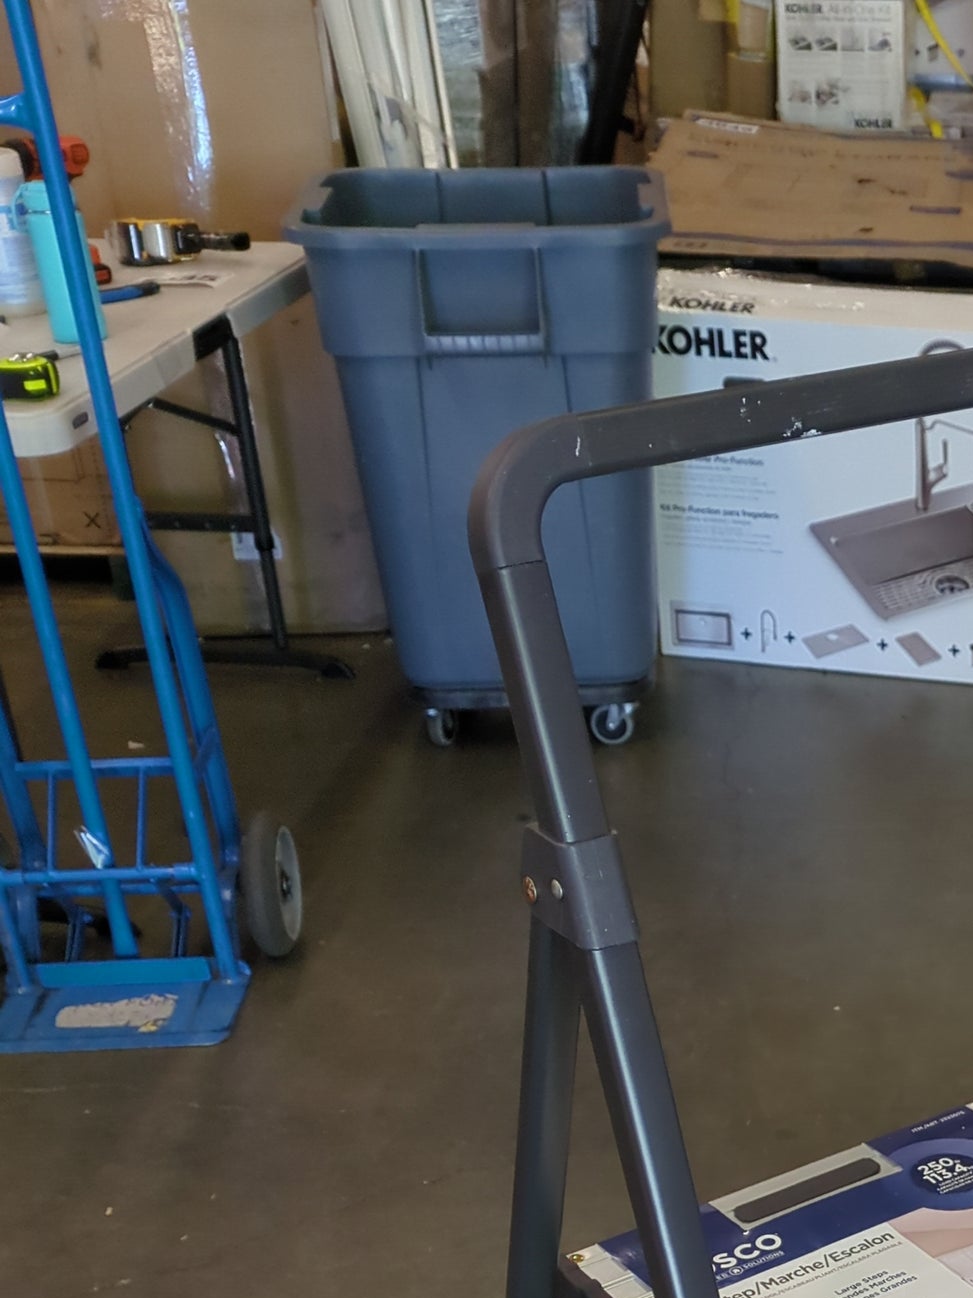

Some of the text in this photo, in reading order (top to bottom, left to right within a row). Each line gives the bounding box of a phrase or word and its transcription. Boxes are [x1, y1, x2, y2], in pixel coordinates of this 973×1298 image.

[785, 4, 823, 13] KOHLER
[854, 118, 893, 129] KOHLER
[669, 297, 756, 314] KOHLER
[652, 325, 770, 362] KOHLER
[917, 1157, 954, 1175] 250
[923, 1164, 968, 1184] 113.4
[712, 1234, 782, 1273] SCO
[743, 1250, 785, 1270] SOLUTIONS
[834, 1269, 889, 1296] Large Steps
[869, 1271, 908, 1290] Marches
[879, 1275, 918, 1293] Grandes
